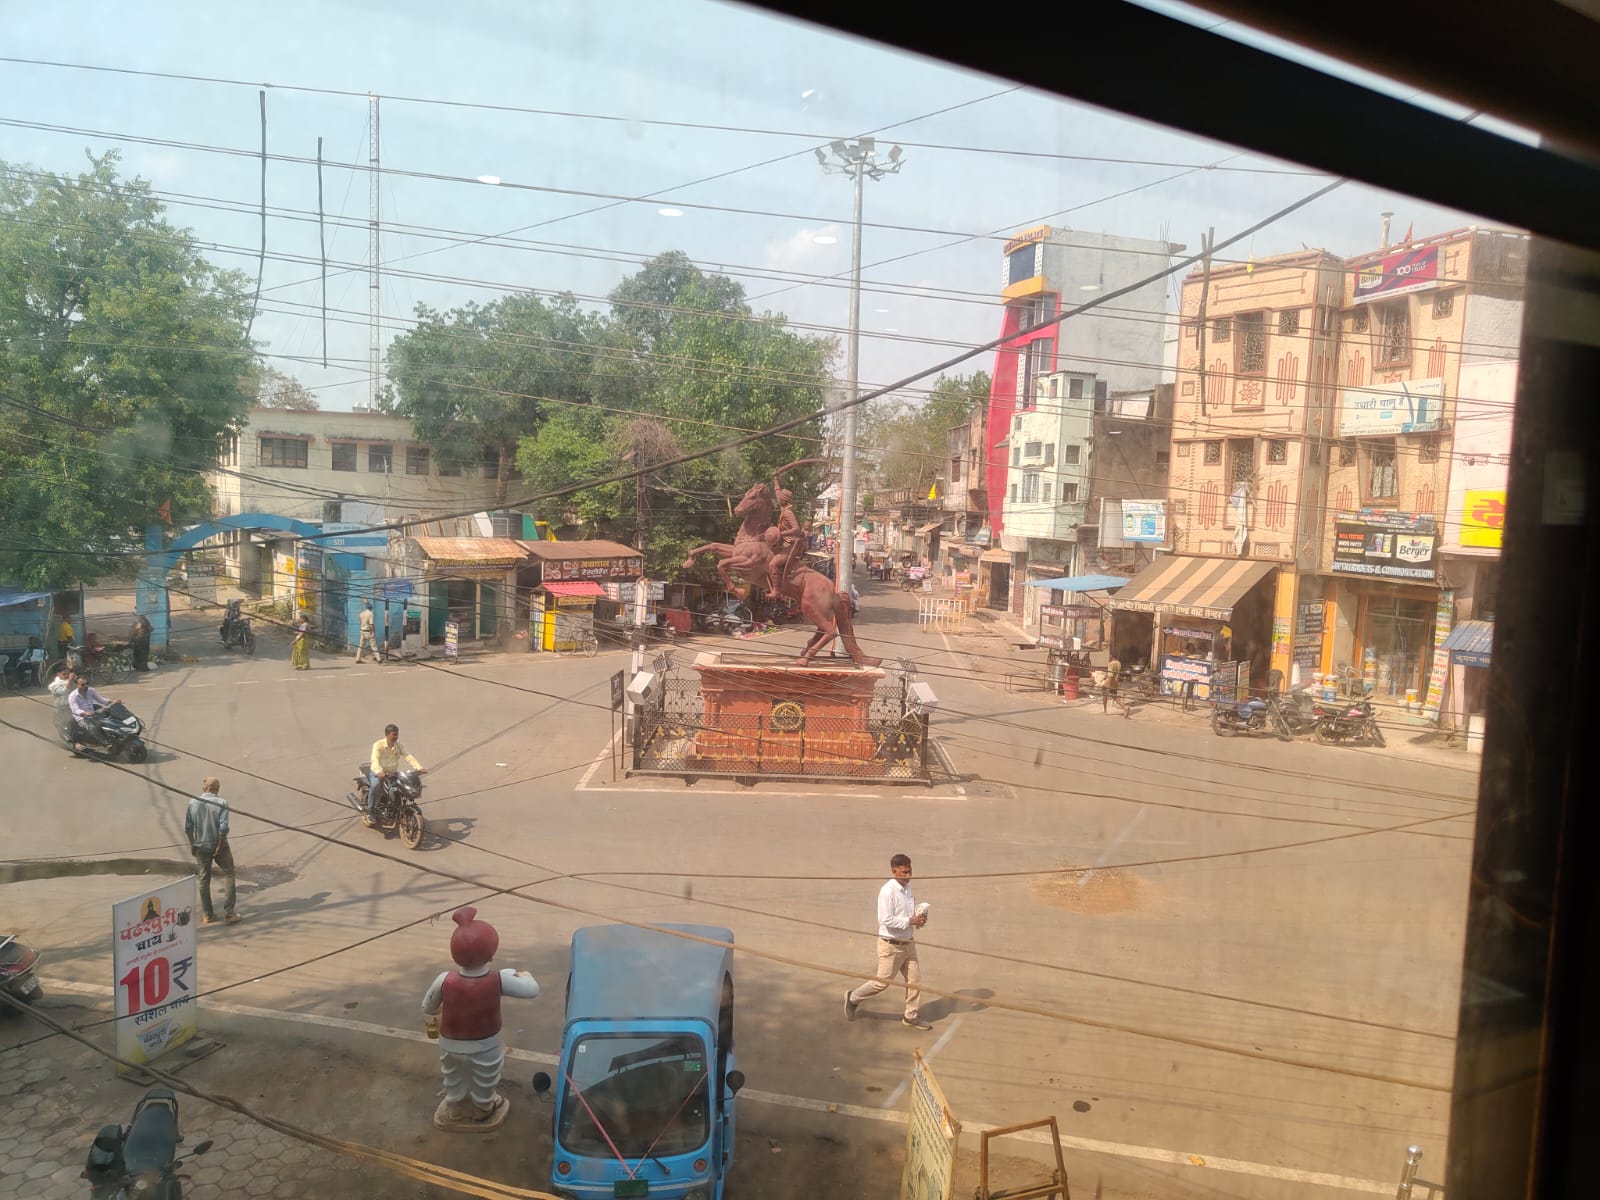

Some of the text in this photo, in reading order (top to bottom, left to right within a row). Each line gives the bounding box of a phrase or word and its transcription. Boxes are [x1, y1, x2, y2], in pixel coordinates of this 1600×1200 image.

[1396, 265, 1411, 275] 100
[1399, 545, 1430, 558] Berger
[120, 907, 177, 941] पंढरपुरी
